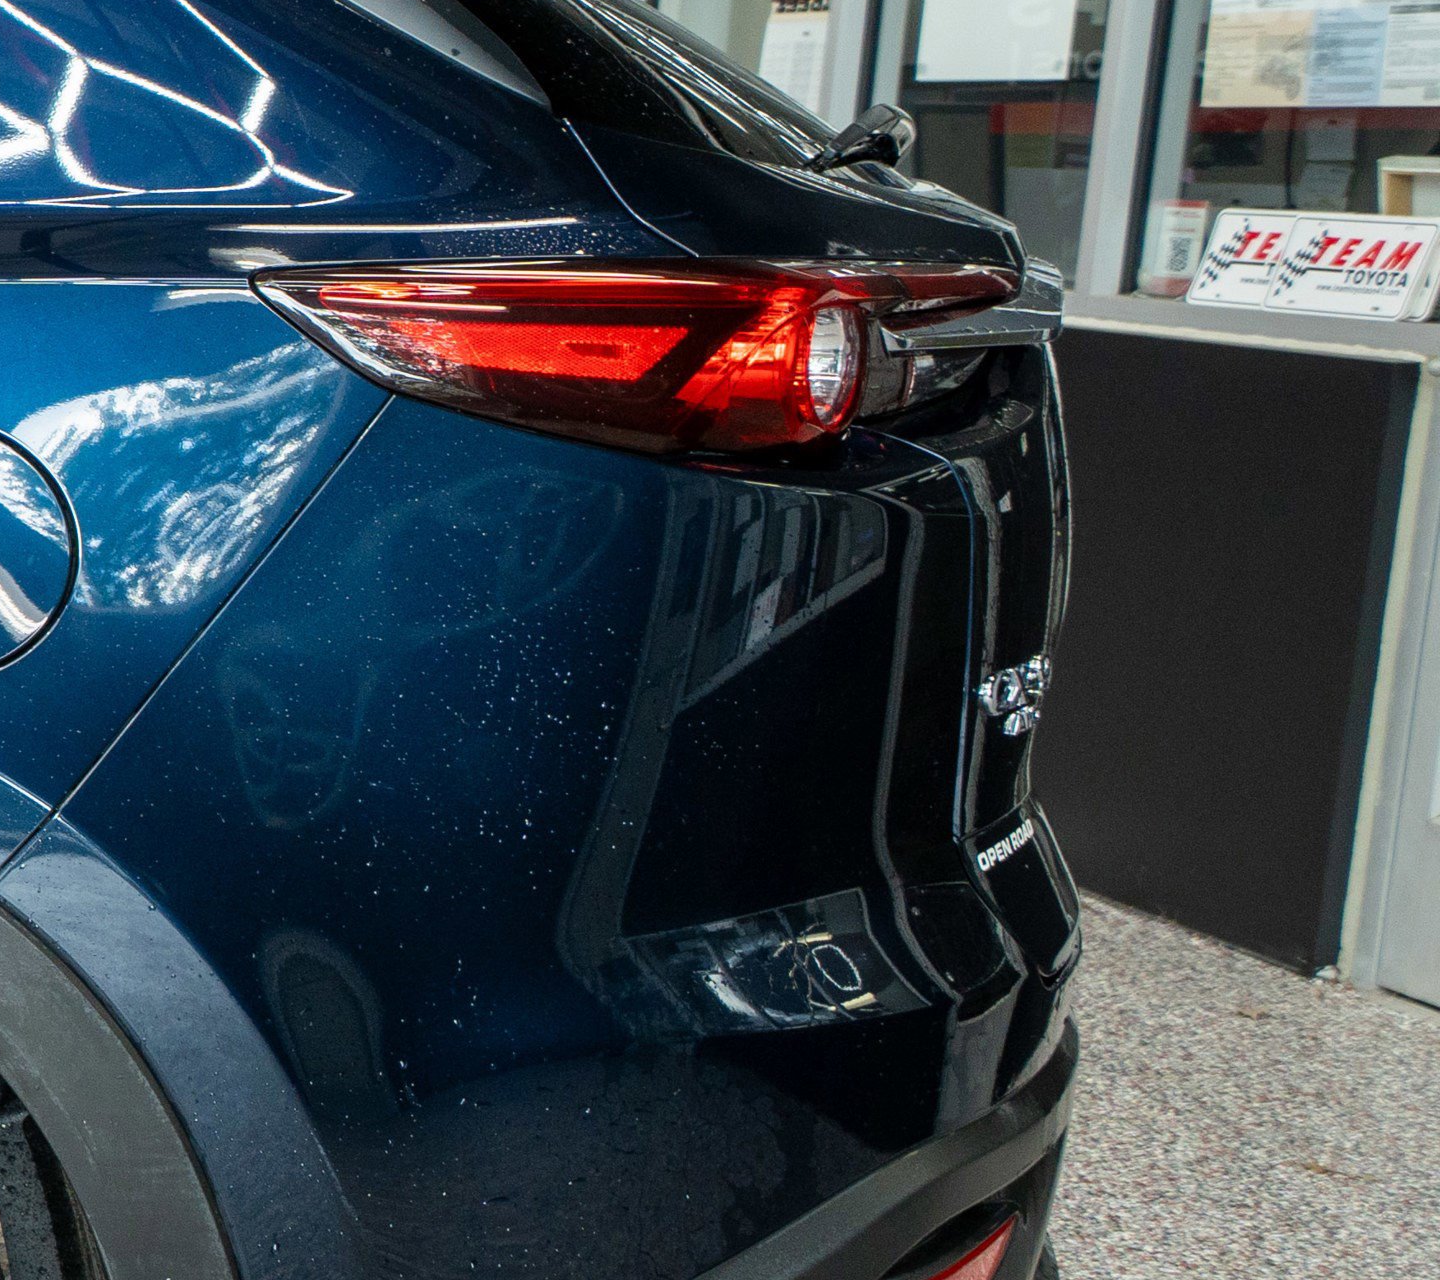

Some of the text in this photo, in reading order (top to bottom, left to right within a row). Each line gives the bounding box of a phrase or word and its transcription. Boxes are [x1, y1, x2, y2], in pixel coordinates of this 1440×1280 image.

[1233, 231, 1281, 260] TE
[1310, 237, 1423, 271] TEAM
[1344, 270, 1408, 288] TOYOTA
[977, 818, 1034, 871] OPEN ROAD
